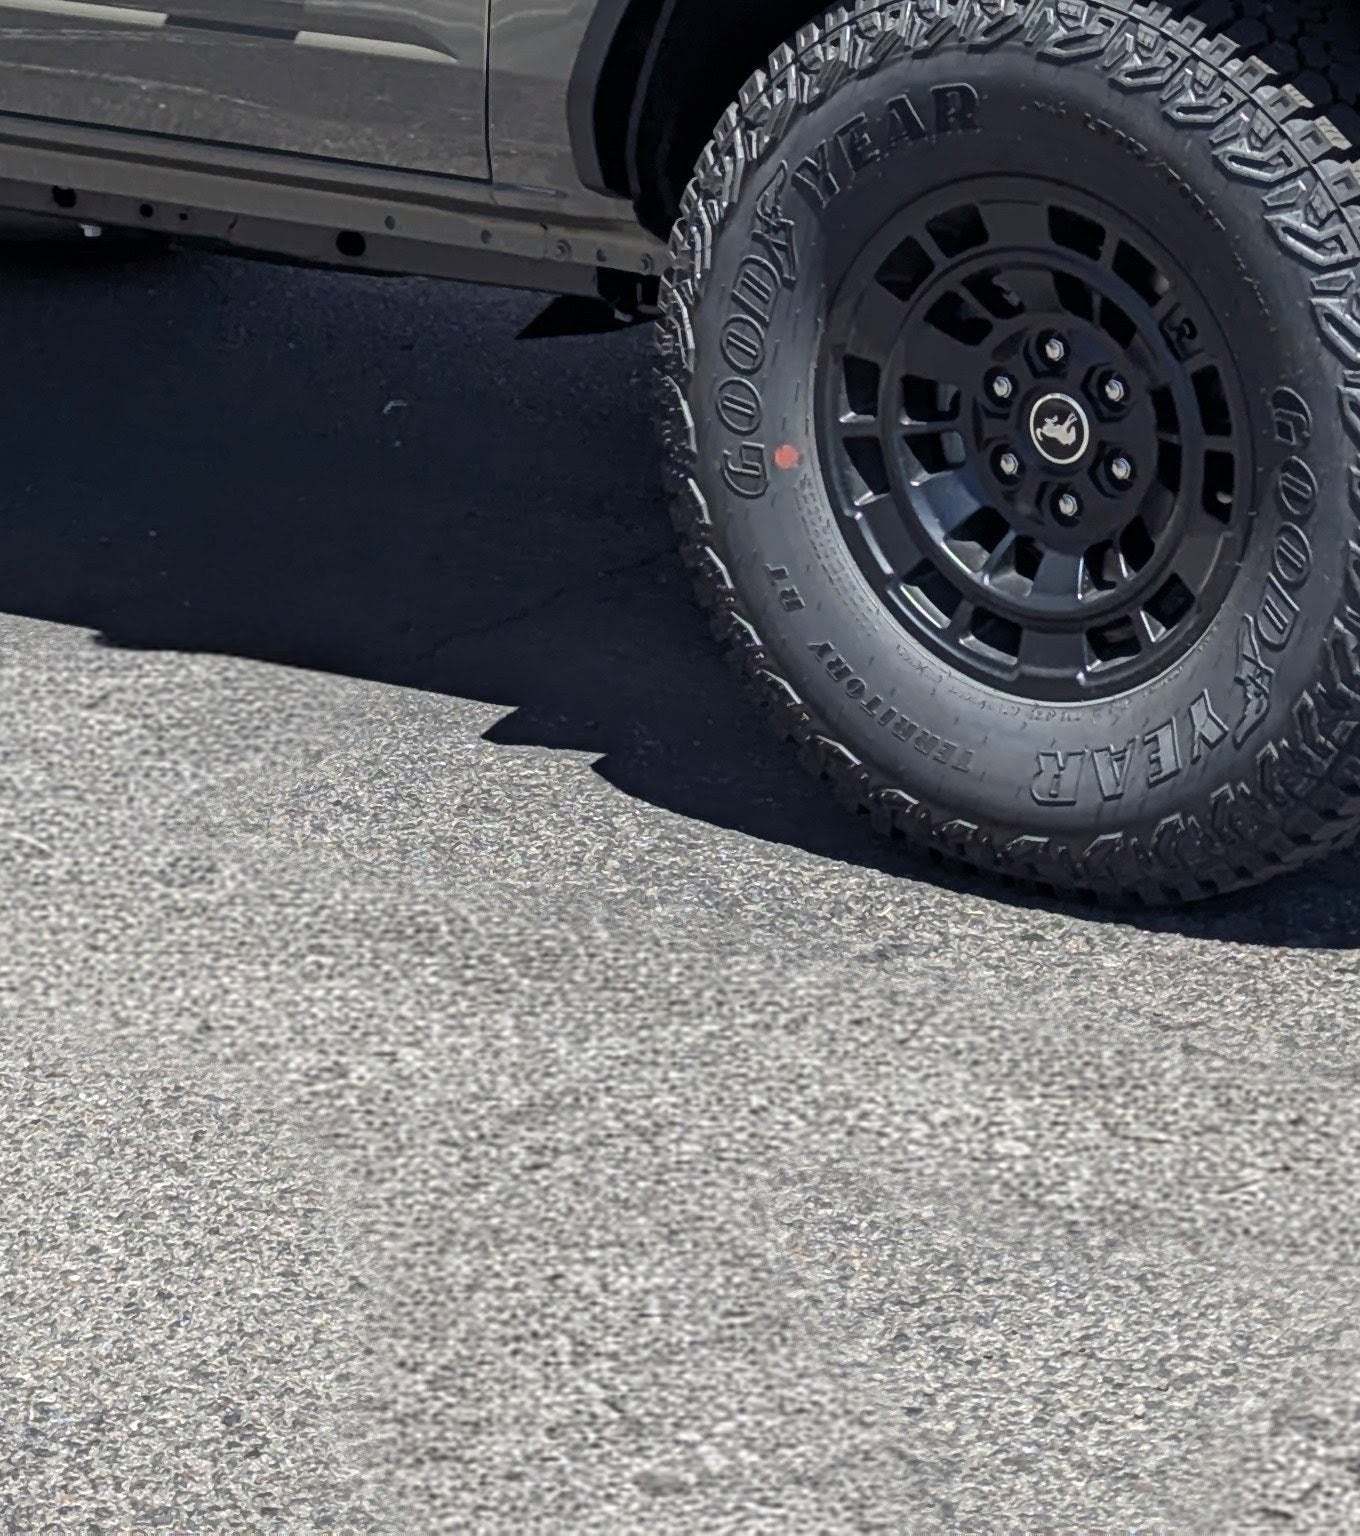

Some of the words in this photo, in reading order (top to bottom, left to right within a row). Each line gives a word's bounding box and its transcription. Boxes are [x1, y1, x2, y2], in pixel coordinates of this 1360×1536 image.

[716, 81, 984, 500] GOODYEAR
[765, 562, 806, 613] RT
[806, 639, 976, 774] TERRITORY
[1030, 385, 1319, 807] GOODYEAR
